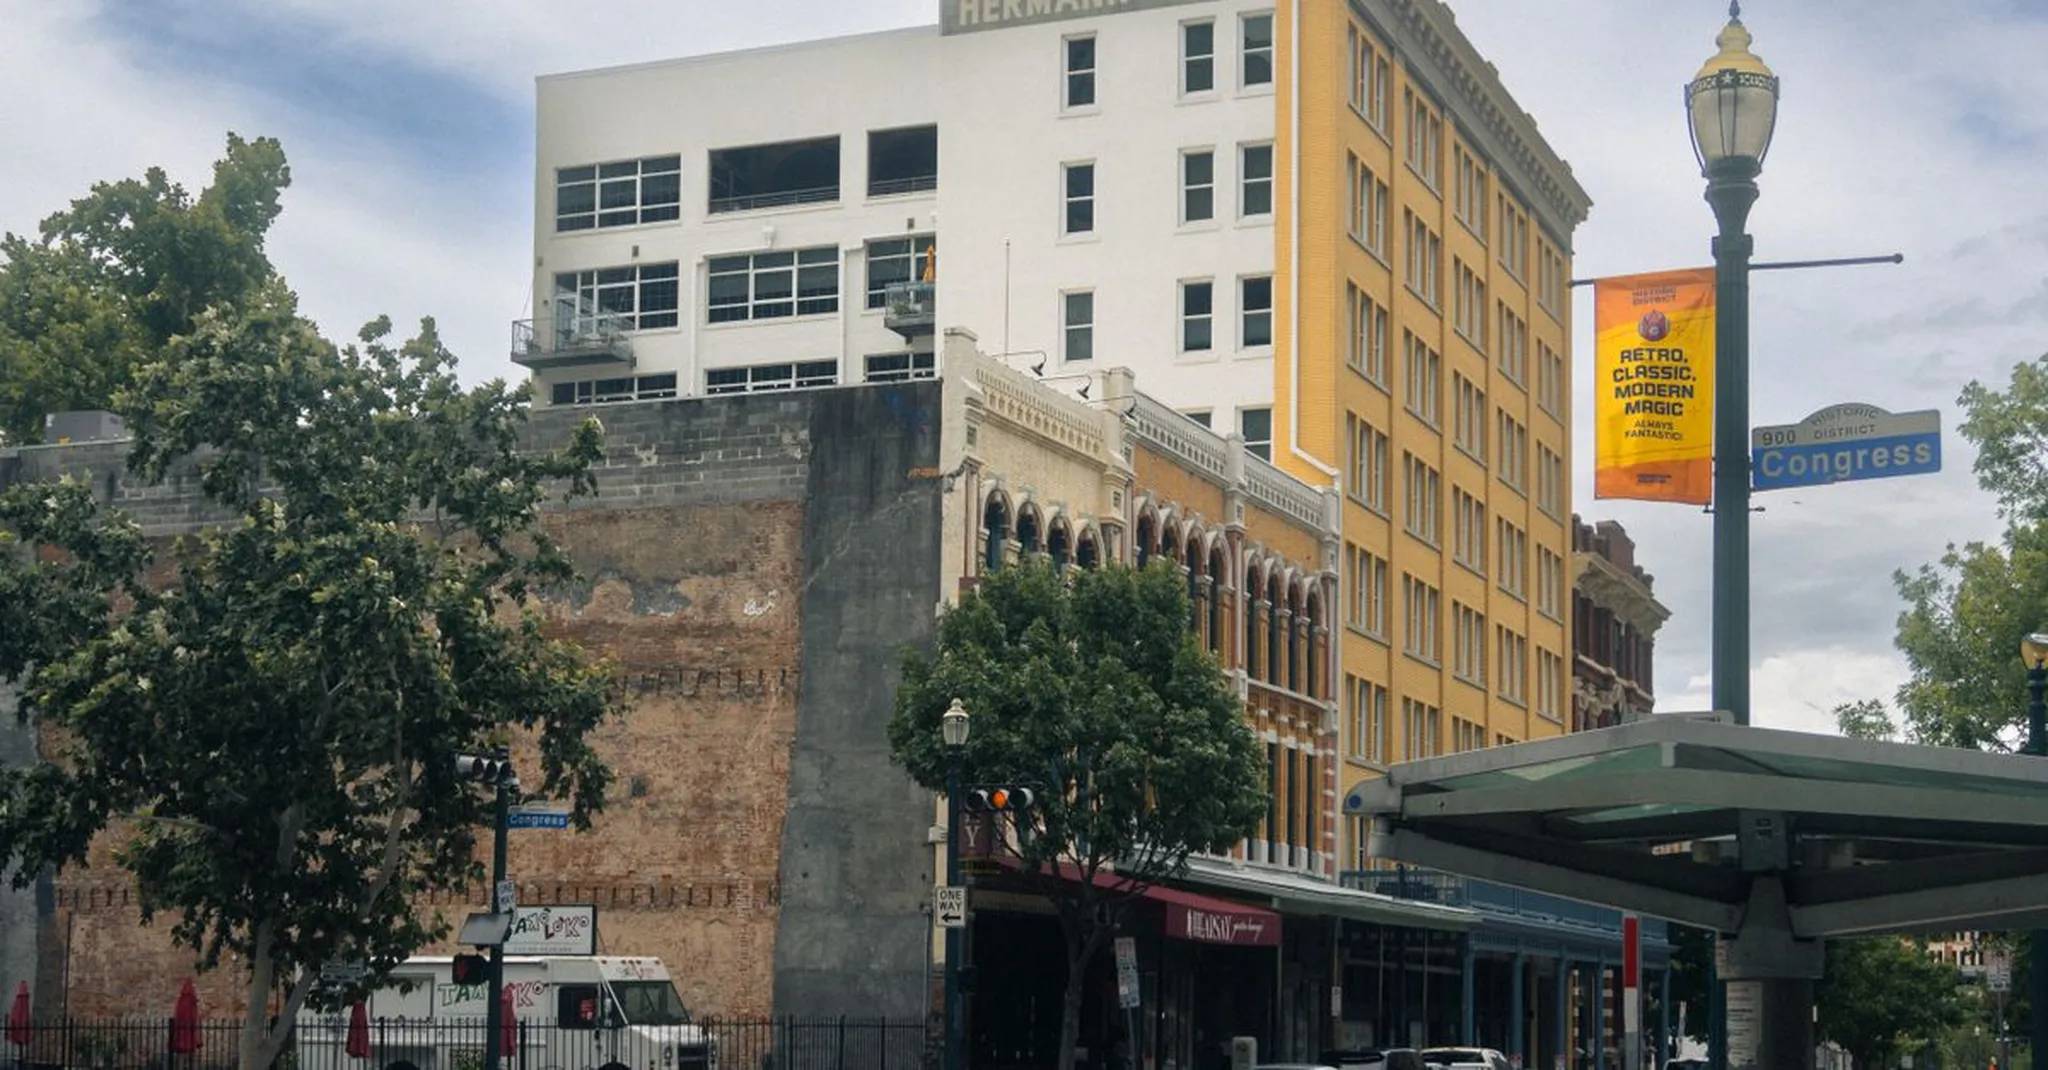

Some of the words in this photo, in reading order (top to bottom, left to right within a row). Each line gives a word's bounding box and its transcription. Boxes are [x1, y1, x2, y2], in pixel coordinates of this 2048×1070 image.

[959, 0, 1127, 26] HERM
[1620, 348, 1688, 364] RETRO.
[1613, 365, 1697, 382] CLASSIC.
[1614, 383, 1694, 399] MODERN
[1625, 401, 1684, 416] MAGIC
[1634, 419, 1674, 431] ALWAYS
[1811, 408, 1879, 427] HISTORIC
[1762, 430, 1796, 446] 900
[1814, 424, 1876, 440] DISTRICT
[1762, 442, 1932, 479] Congress
[509, 814, 566, 828] Congress
[940, 890, 962, 900] ONE
[940, 901, 962, 912] WAY
